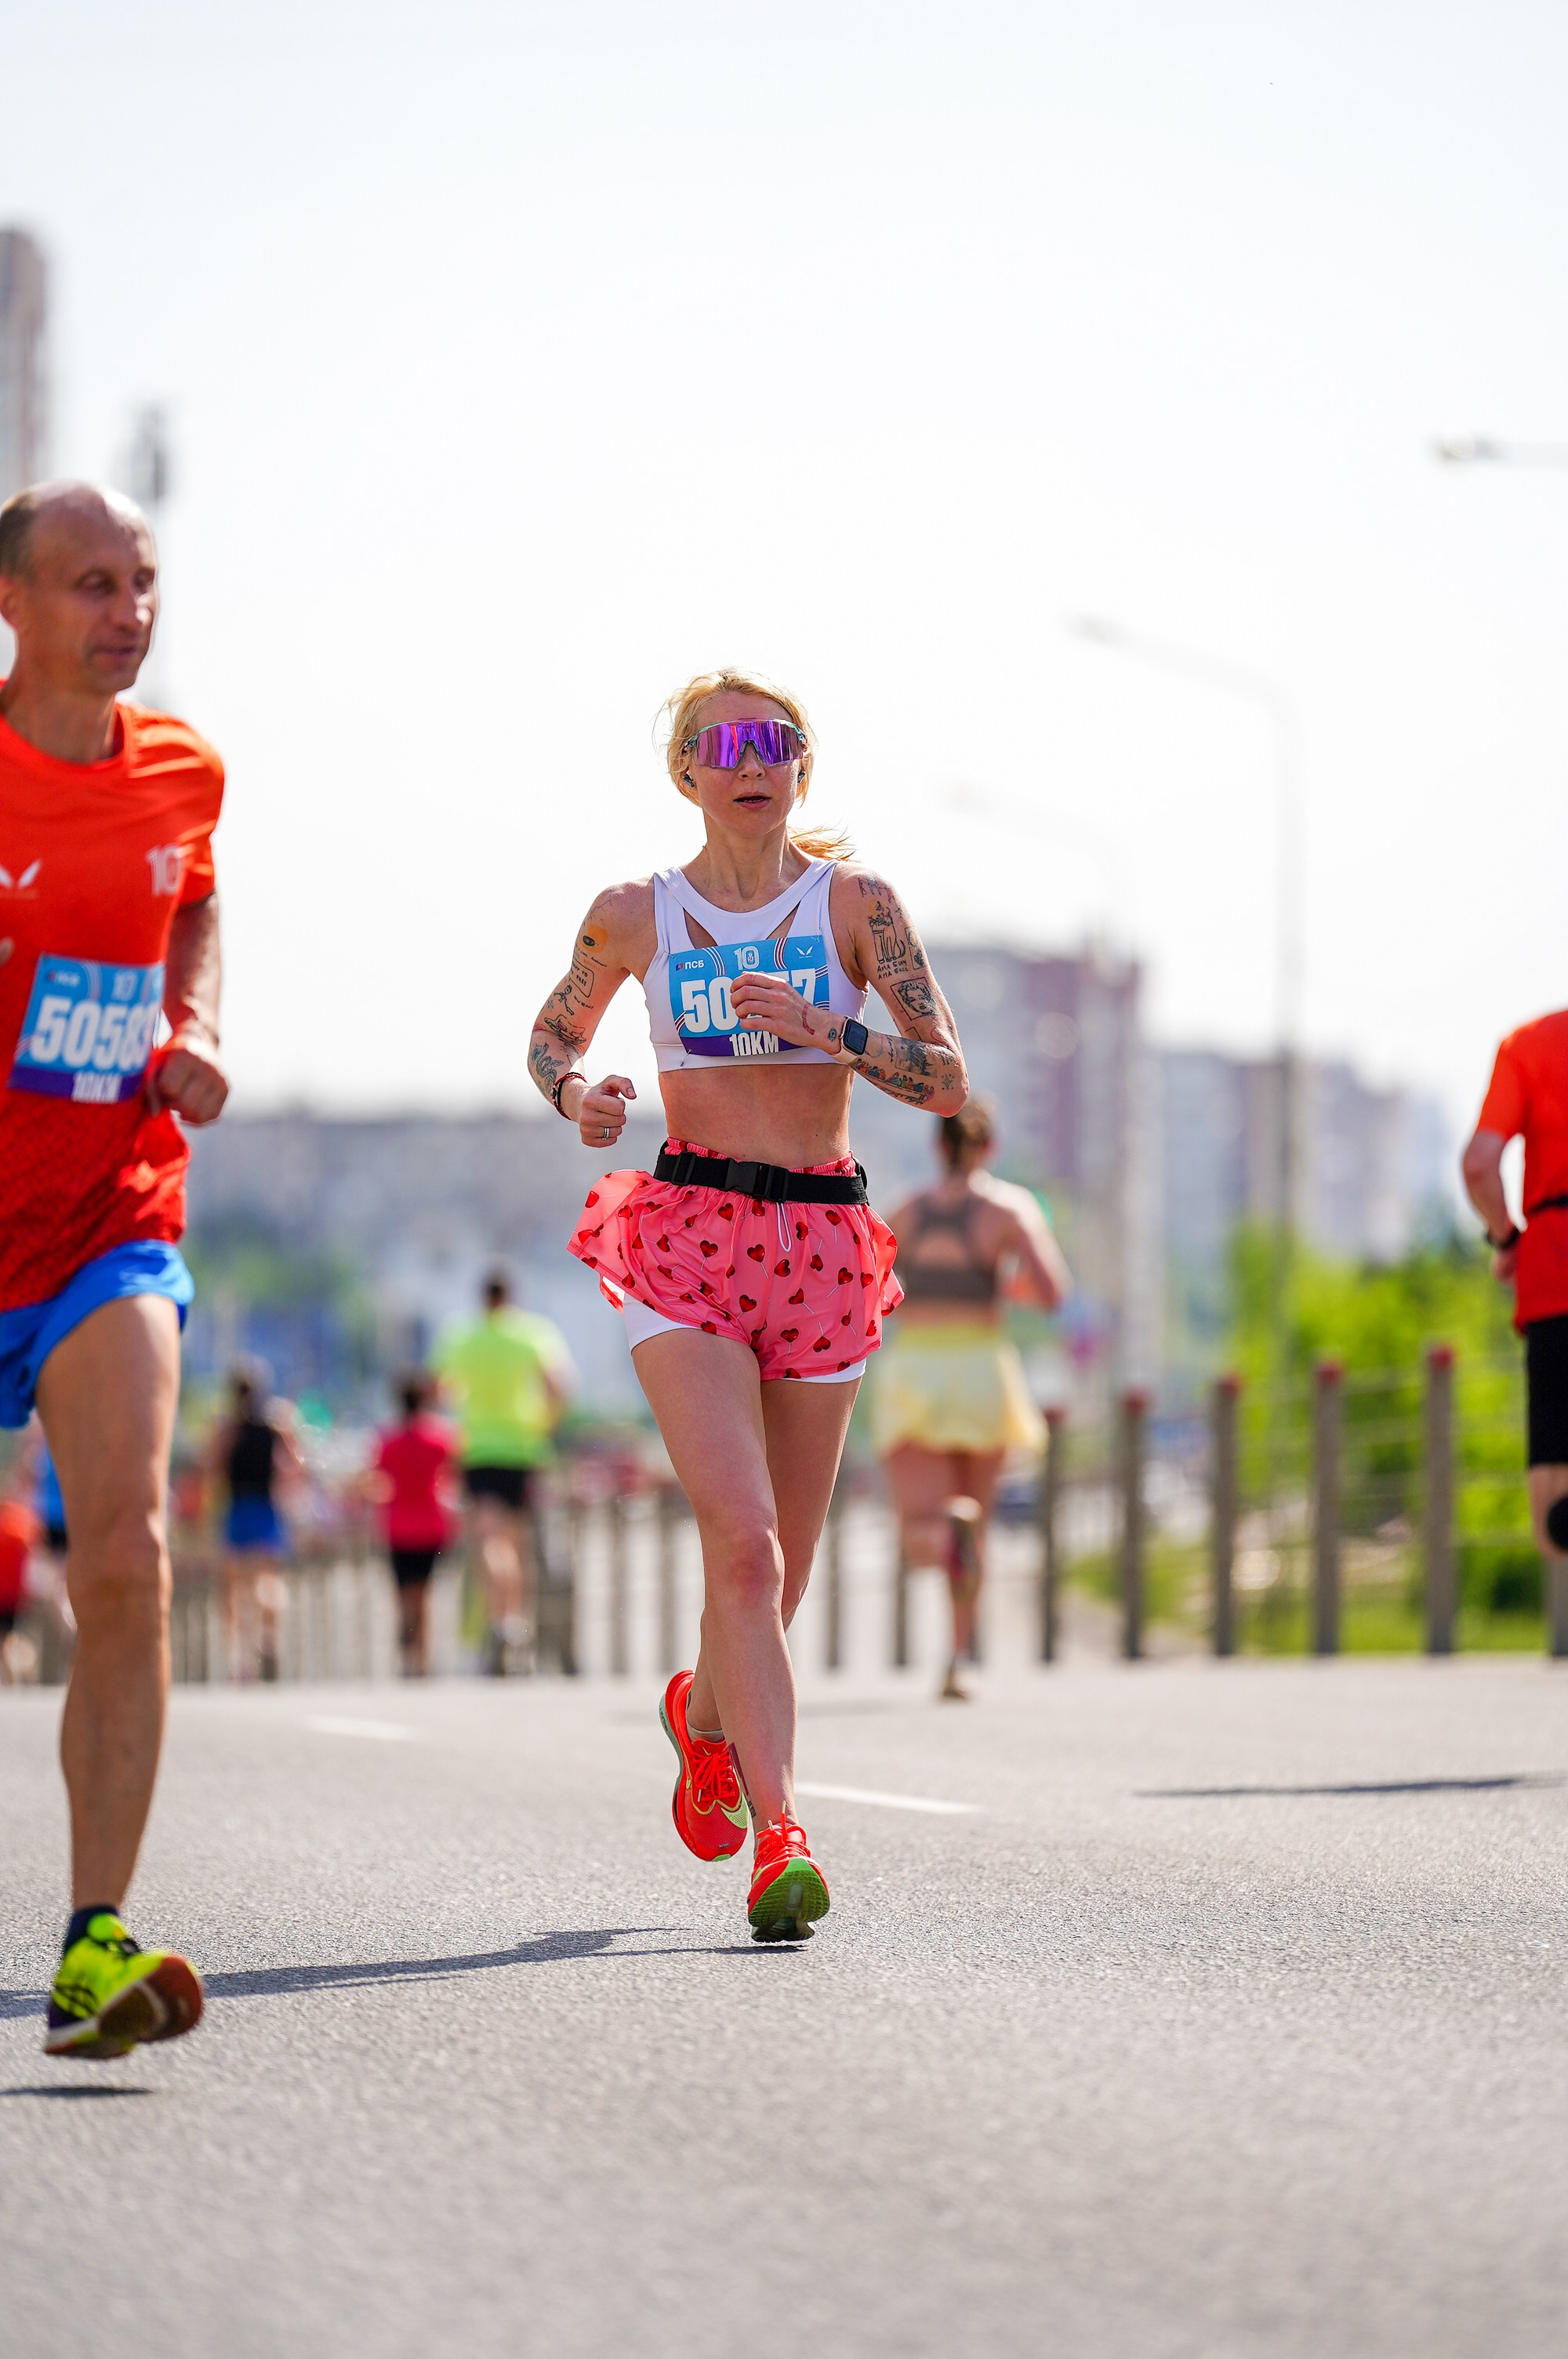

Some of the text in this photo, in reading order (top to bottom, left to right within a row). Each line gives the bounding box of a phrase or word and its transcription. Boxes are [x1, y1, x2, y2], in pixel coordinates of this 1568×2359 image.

[684, 959, 705, 970] ПСБ
[734, 946, 759, 970] 10
[681, 969, 816, 1033] 507
[728, 1030, 779, 1057] 10KM
